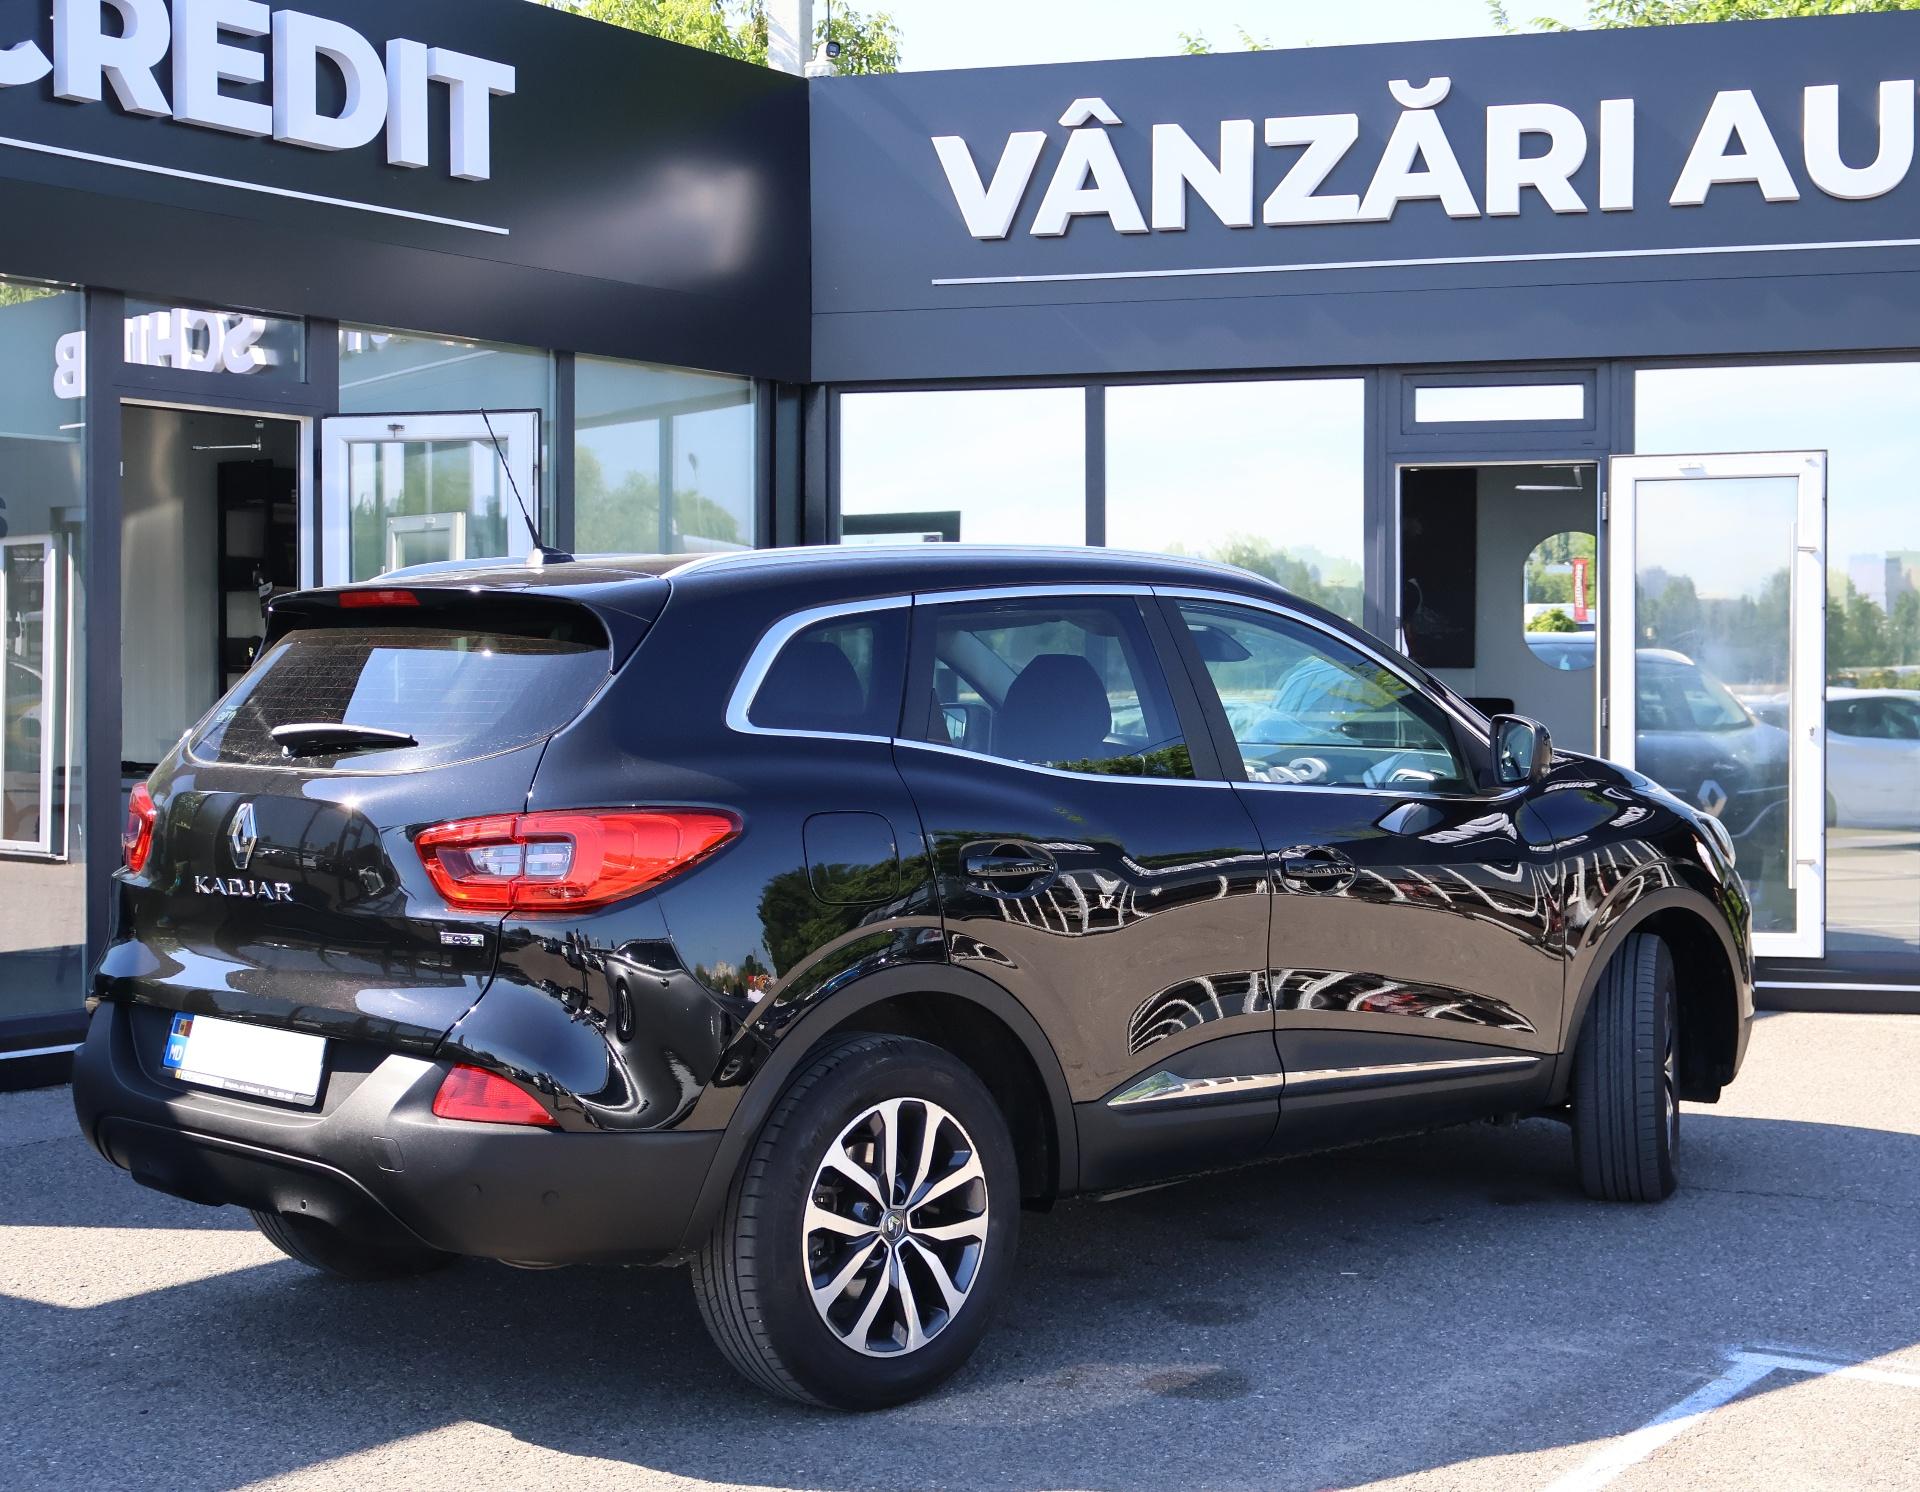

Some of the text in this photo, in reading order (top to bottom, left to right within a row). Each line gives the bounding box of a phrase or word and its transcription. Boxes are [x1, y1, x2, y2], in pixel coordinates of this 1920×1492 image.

[930, 76, 1635, 239] VÂNZĂRI
[194, 875, 294, 902] KADJAR
[168, 1043, 184, 1062] MD
